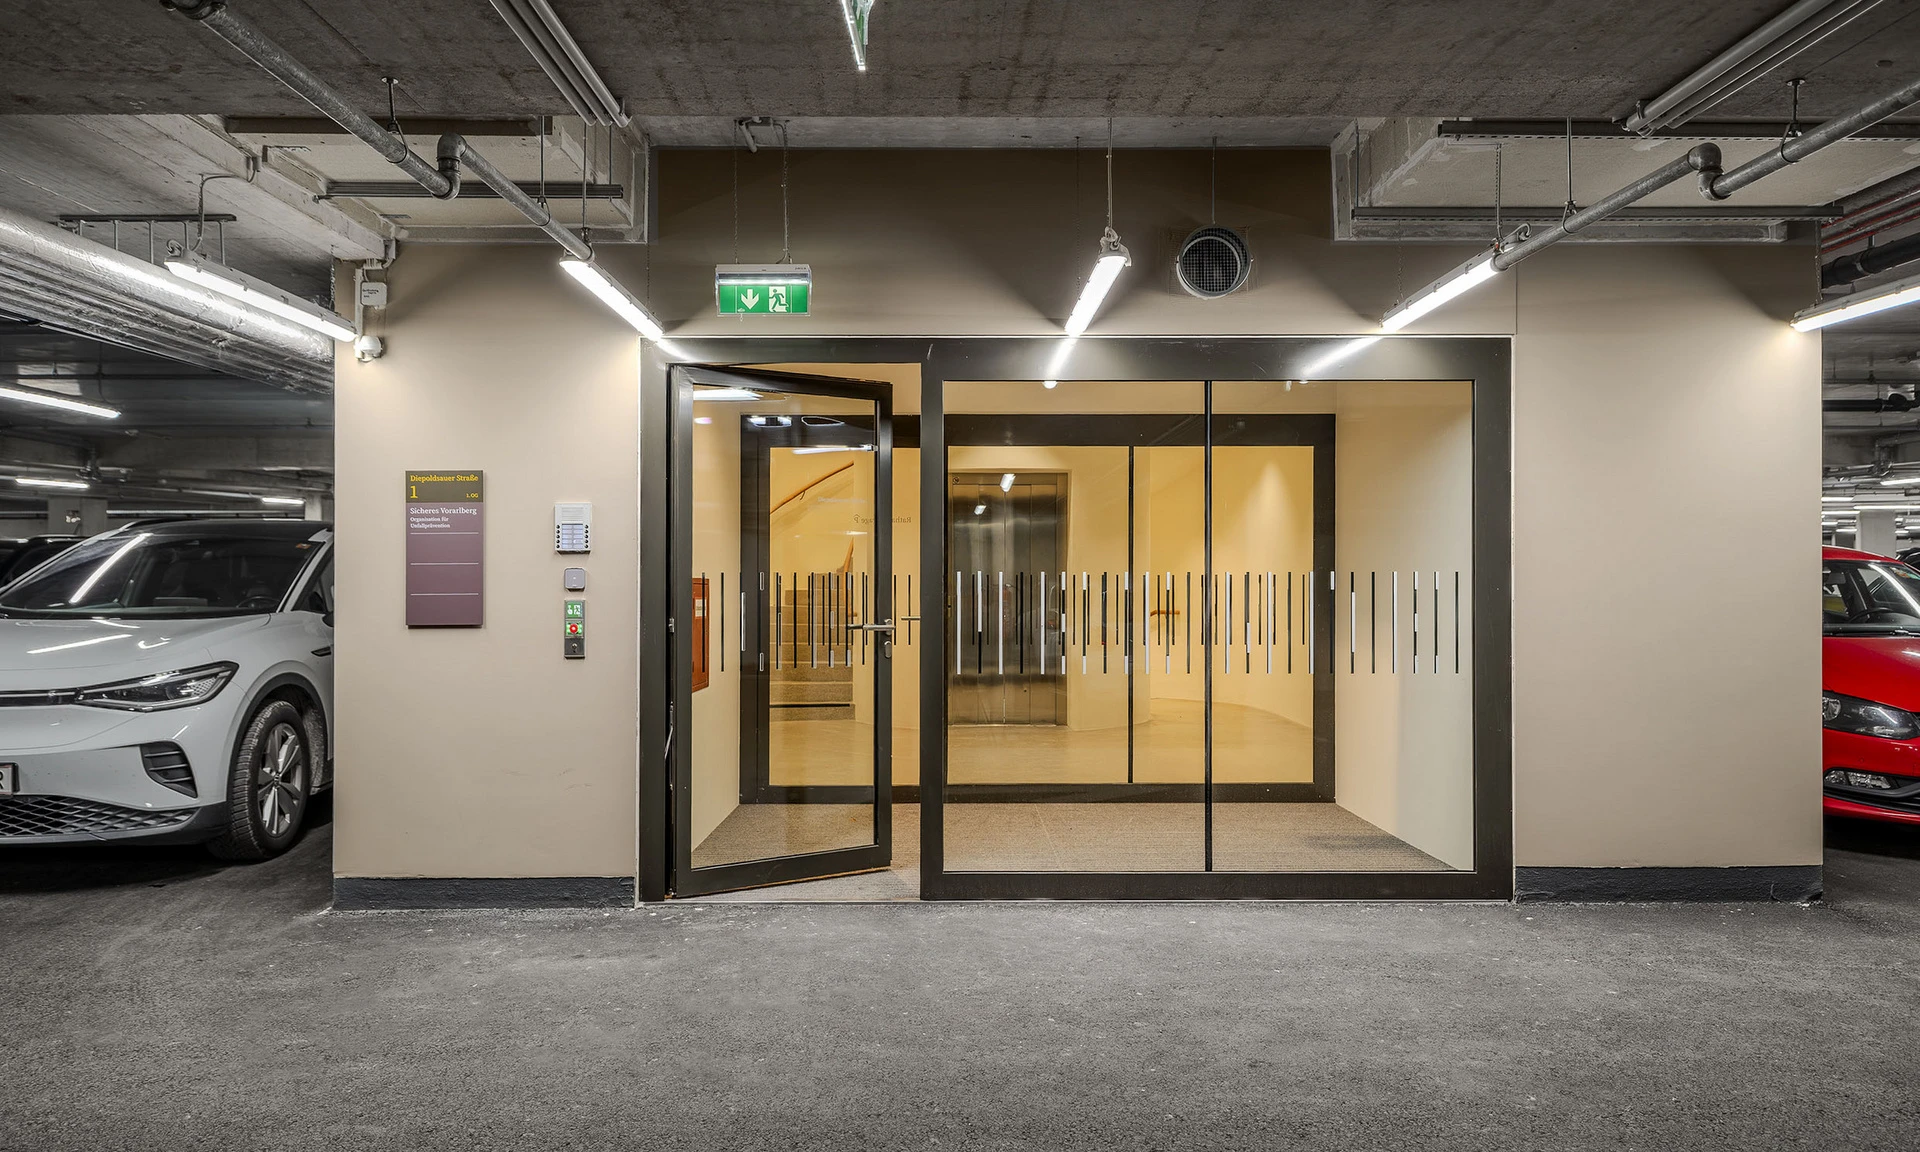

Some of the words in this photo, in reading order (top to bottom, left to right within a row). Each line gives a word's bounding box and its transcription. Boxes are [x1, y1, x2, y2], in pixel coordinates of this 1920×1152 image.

[410, 474, 455, 483] Diepoldsauer
[410, 486, 418, 499] 1
[410, 507, 439, 515] Sicheres
[440, 507, 477, 515] Vorarlberg
